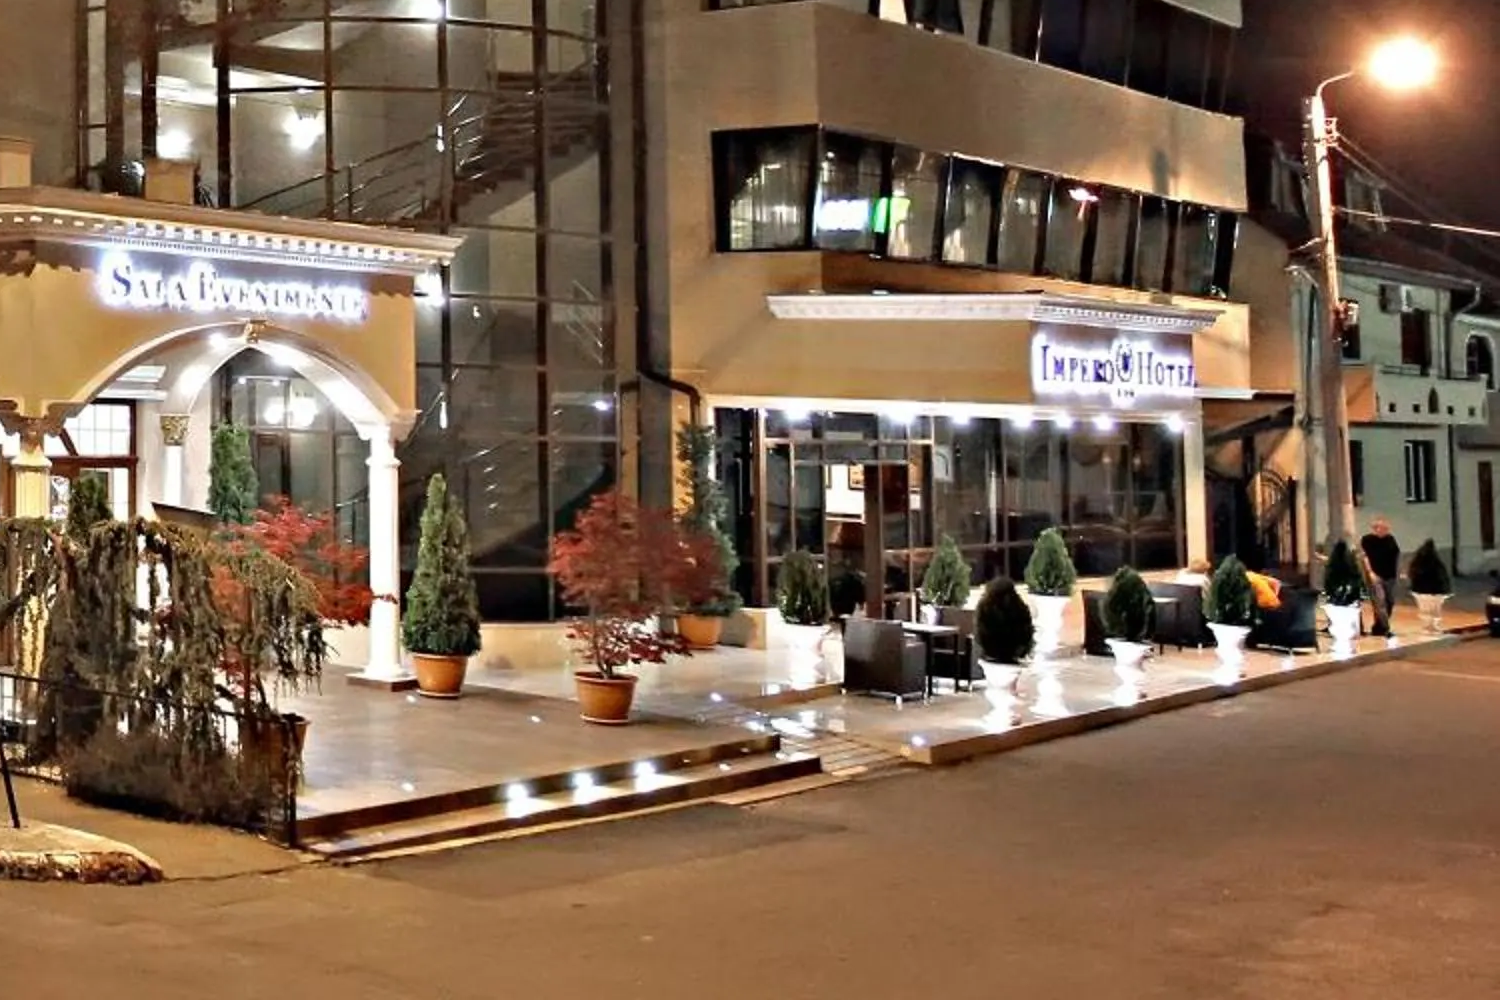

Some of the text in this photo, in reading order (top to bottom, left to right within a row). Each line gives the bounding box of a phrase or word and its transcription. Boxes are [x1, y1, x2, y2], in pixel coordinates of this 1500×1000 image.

[111, 264, 187, 302] SALA
[1040, 344, 1198, 388] IMPERO HOTEL
